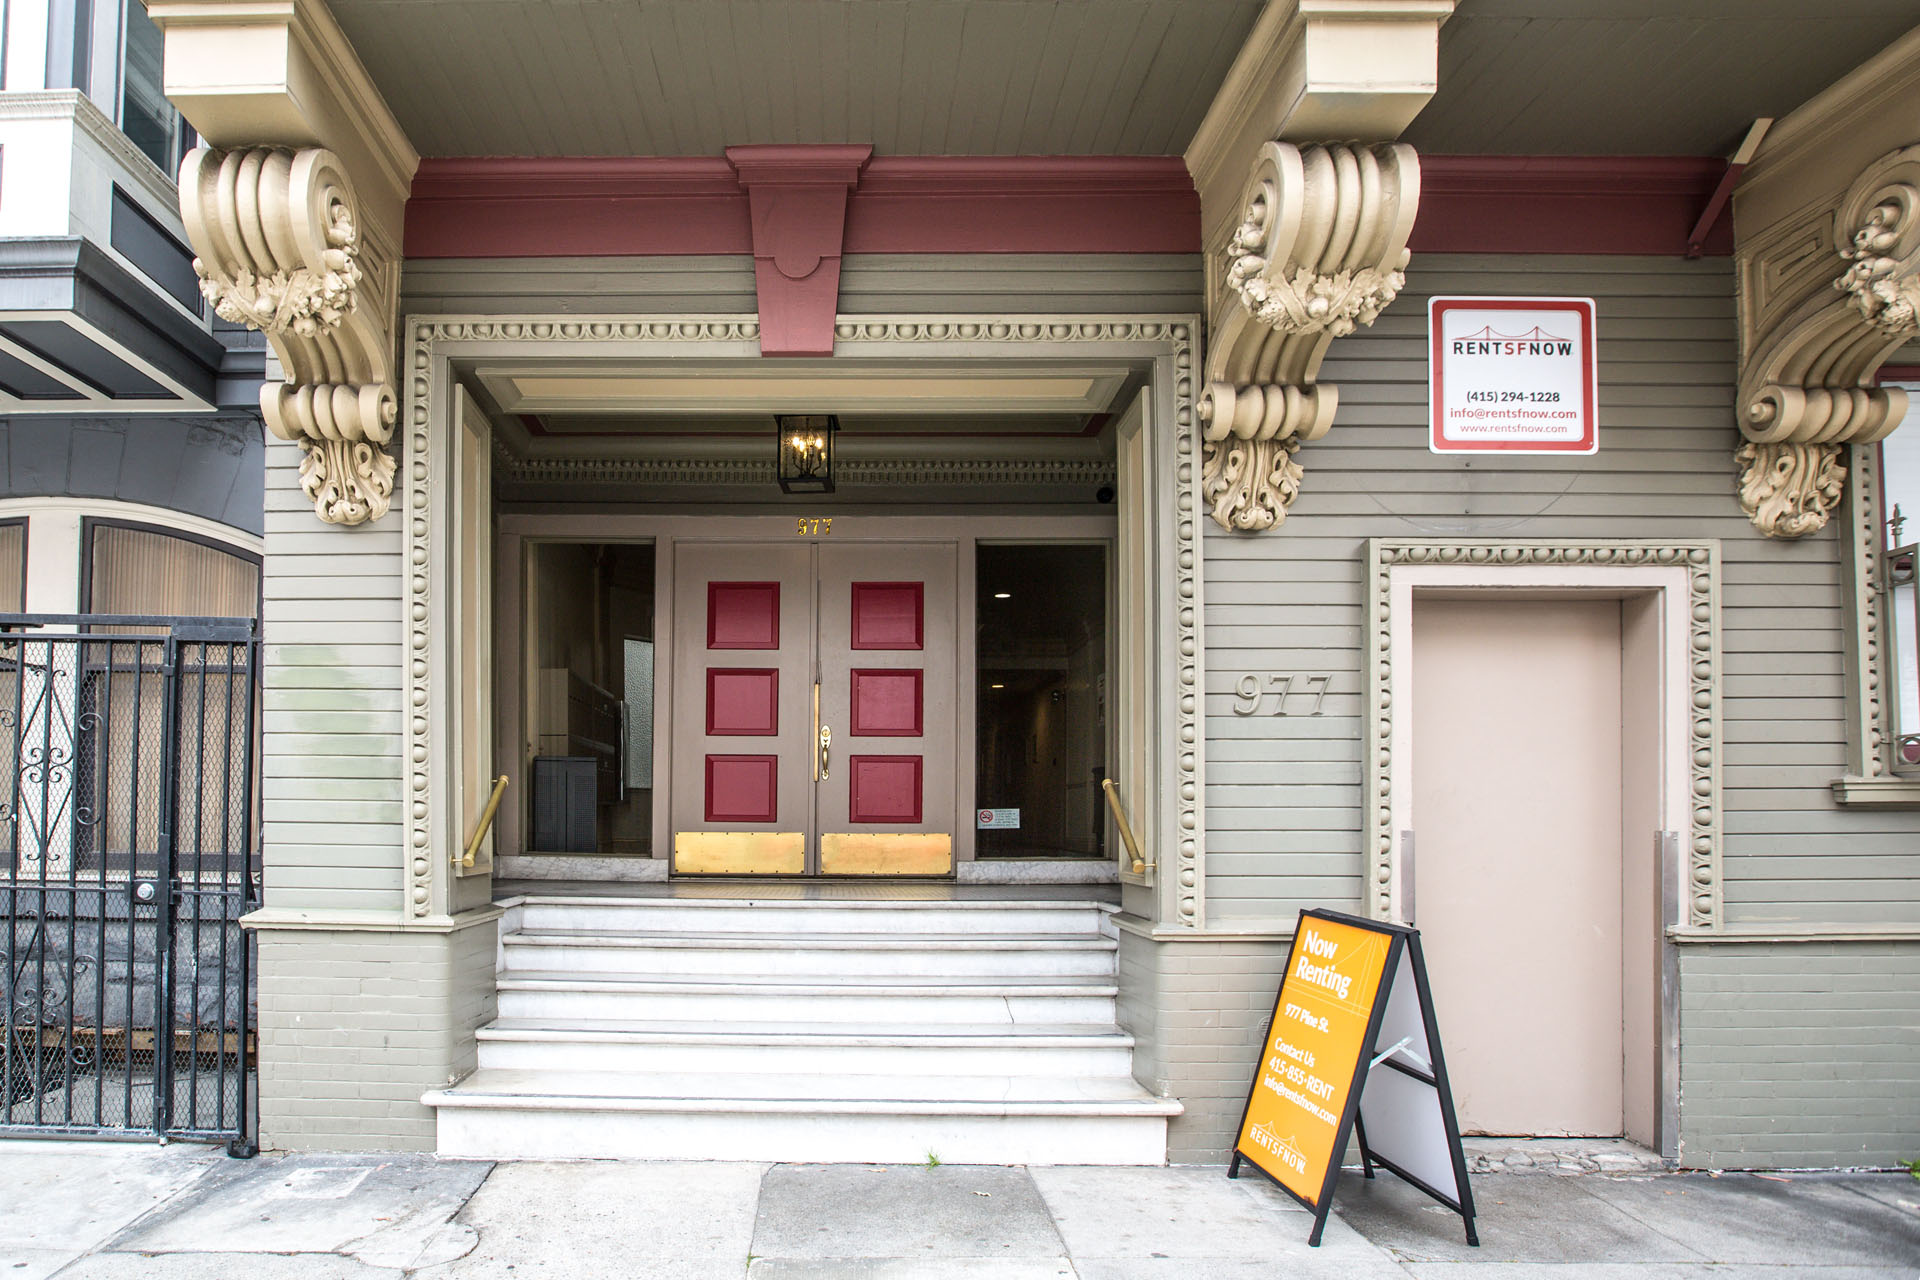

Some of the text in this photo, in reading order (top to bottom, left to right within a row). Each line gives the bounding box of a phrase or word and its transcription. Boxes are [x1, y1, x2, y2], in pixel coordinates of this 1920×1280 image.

[1453, 341, 1572, 356] RENTSFNOW
[1466, 391, 1560, 403] (415) 294-1228
[1450, 408, 1577, 420] info@rentsfnow.com
[1460, 424, 1568, 433] www.rentsfnow.com
[798, 518, 832, 536] 977
[1233, 674, 1332, 716] 977
[1303, 929, 1338, 960] Now
[1296, 955, 1352, 999] Renting
[1285, 1003, 1301, 1020] 977
[1300, 1008, 1318, 1028] Pine
[1275, 1037, 1316, 1067] Contact Us
[1264, 1074, 1338, 1126] info@rentsfnow.com
